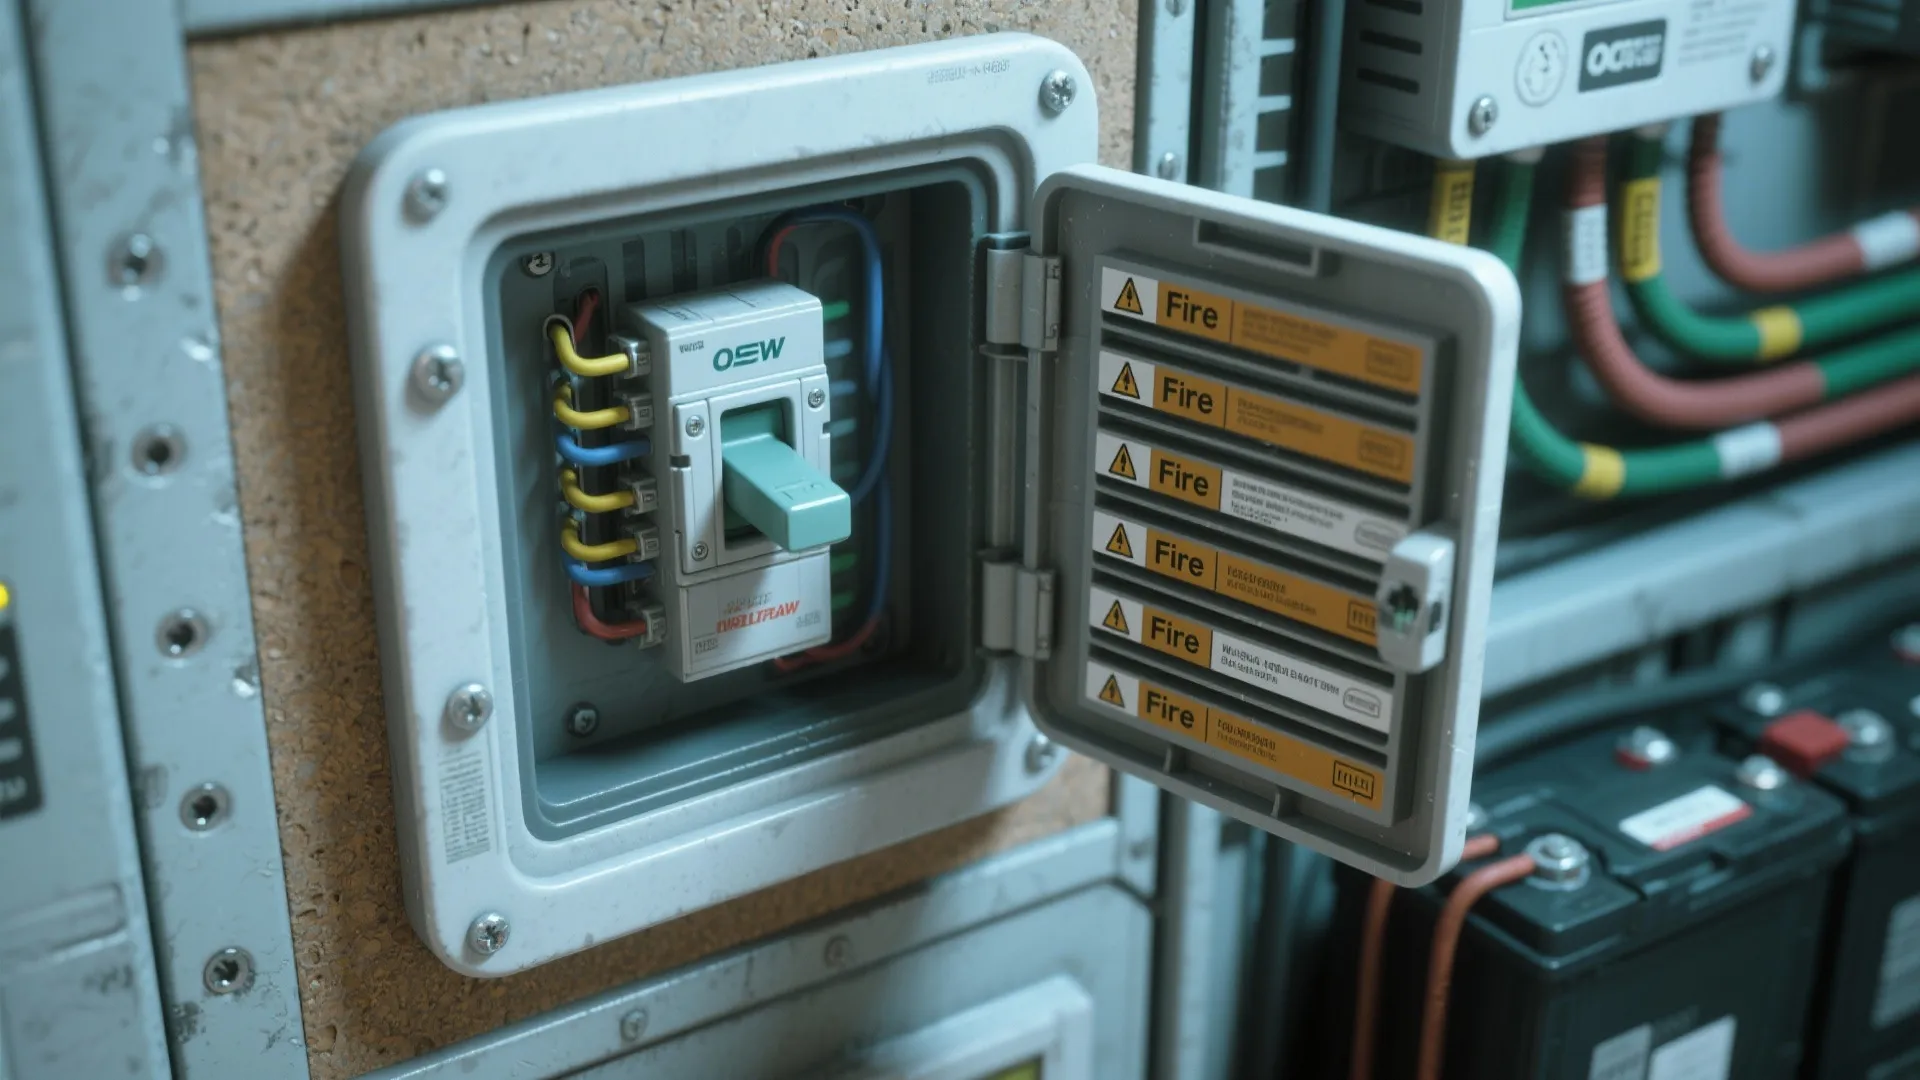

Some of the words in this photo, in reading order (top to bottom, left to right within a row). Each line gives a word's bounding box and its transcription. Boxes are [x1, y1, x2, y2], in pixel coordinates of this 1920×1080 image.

[1165, 291, 1218, 329] Fire
[1162, 376, 1213, 414] Fire
[1159, 458, 1208, 496] Fire
[1155, 539, 1204, 576] Fire
[1151, 616, 1199, 653] Fire
[1146, 691, 1194, 728] Fire
